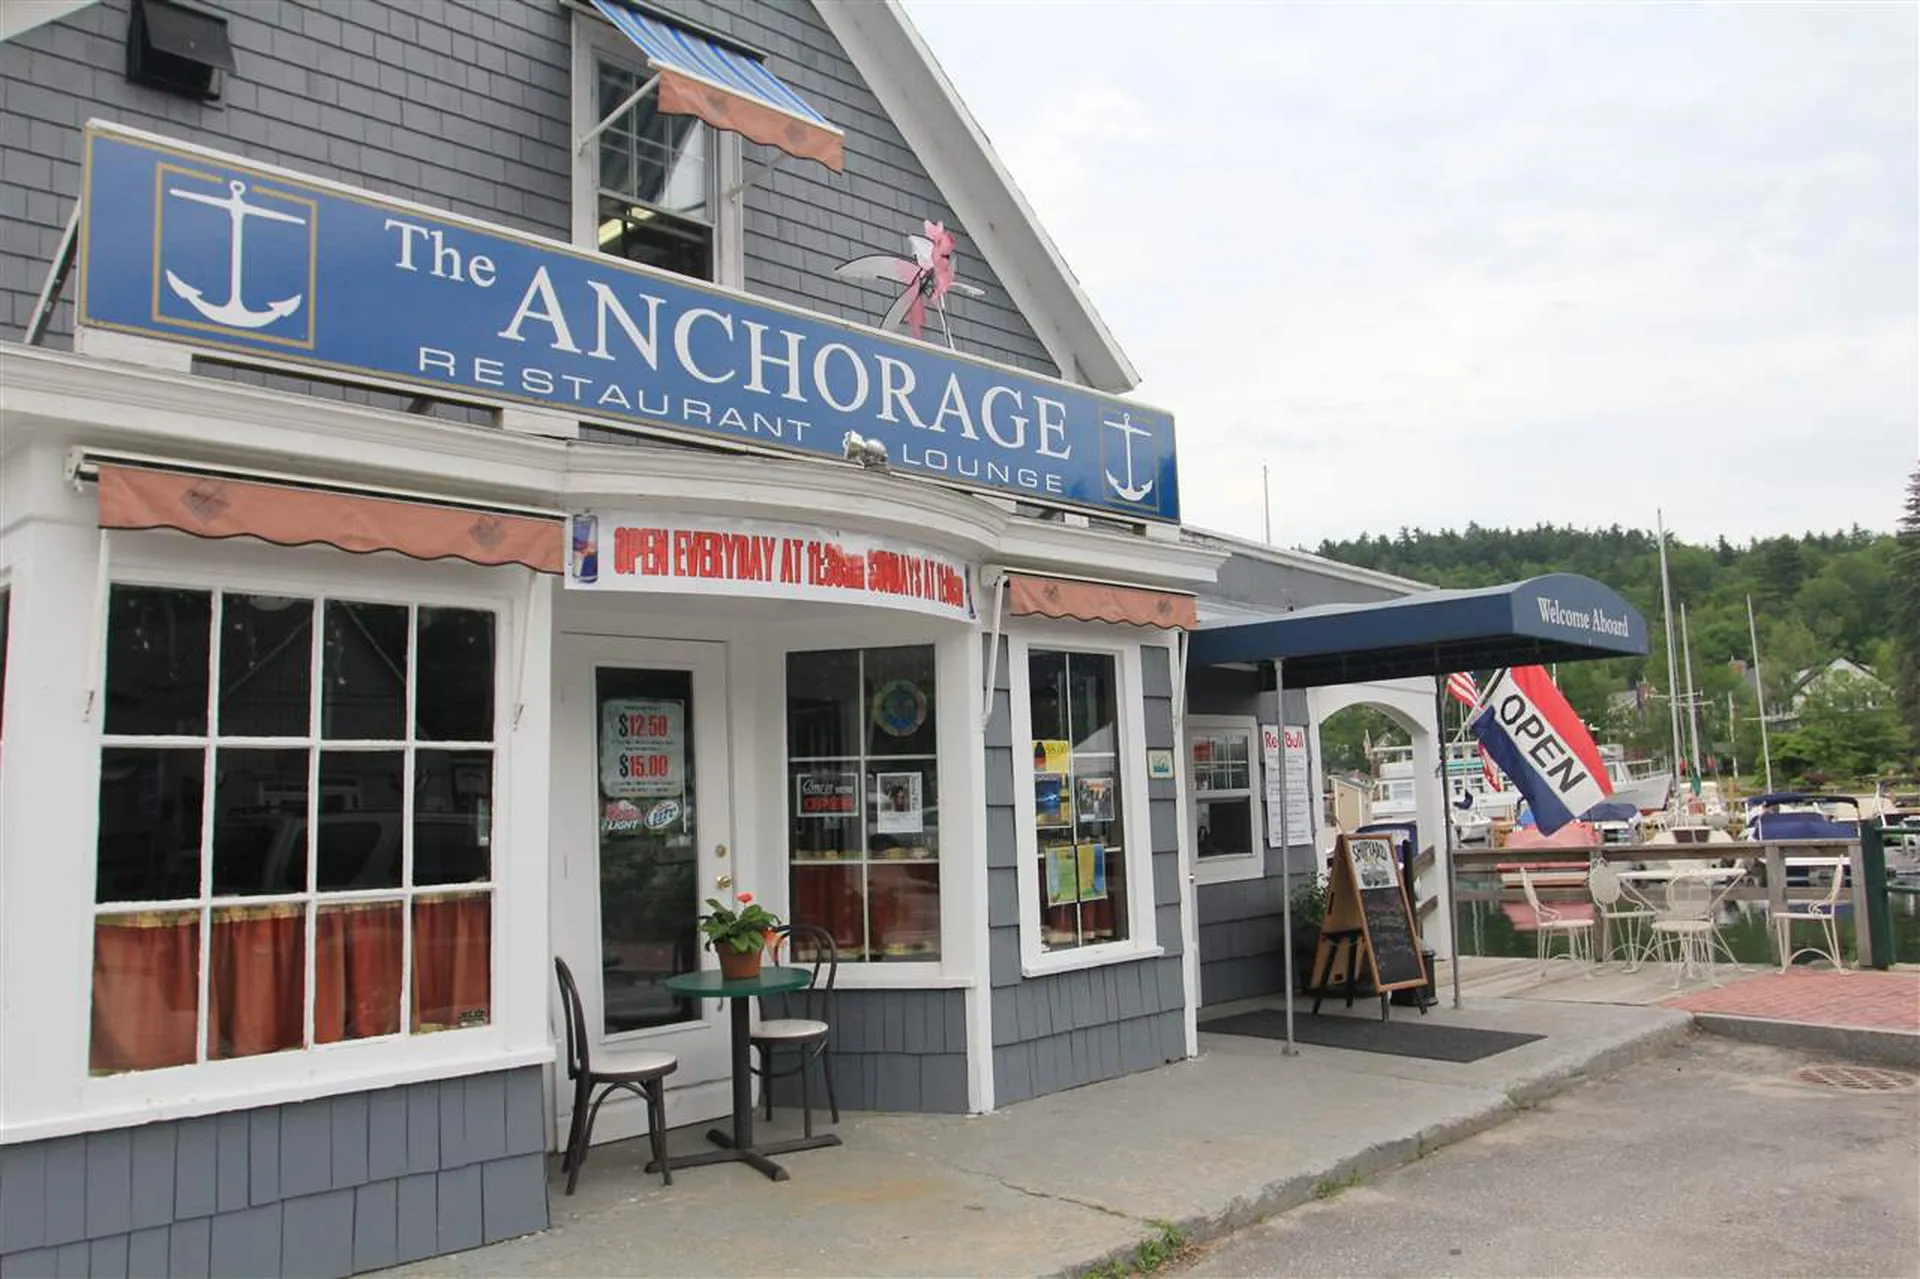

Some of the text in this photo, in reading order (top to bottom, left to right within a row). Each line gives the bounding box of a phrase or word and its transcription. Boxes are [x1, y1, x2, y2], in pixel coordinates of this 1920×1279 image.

[384, 218, 496, 287] The
[498, 265, 1072, 460] ANCHORAGE
[419, 346, 1063, 493] RESTAURANT LOUNGE
[614, 527, 669, 576] OPEN
[673, 530, 776, 581] EVERYDAY
[780, 538, 804, 584] AT
[1536, 596, 1630, 637] Welcome Aboard
[618, 713, 669, 738] $12.50
[1500, 693, 1588, 794] OPEN
[618, 754, 669, 778] $15.00
